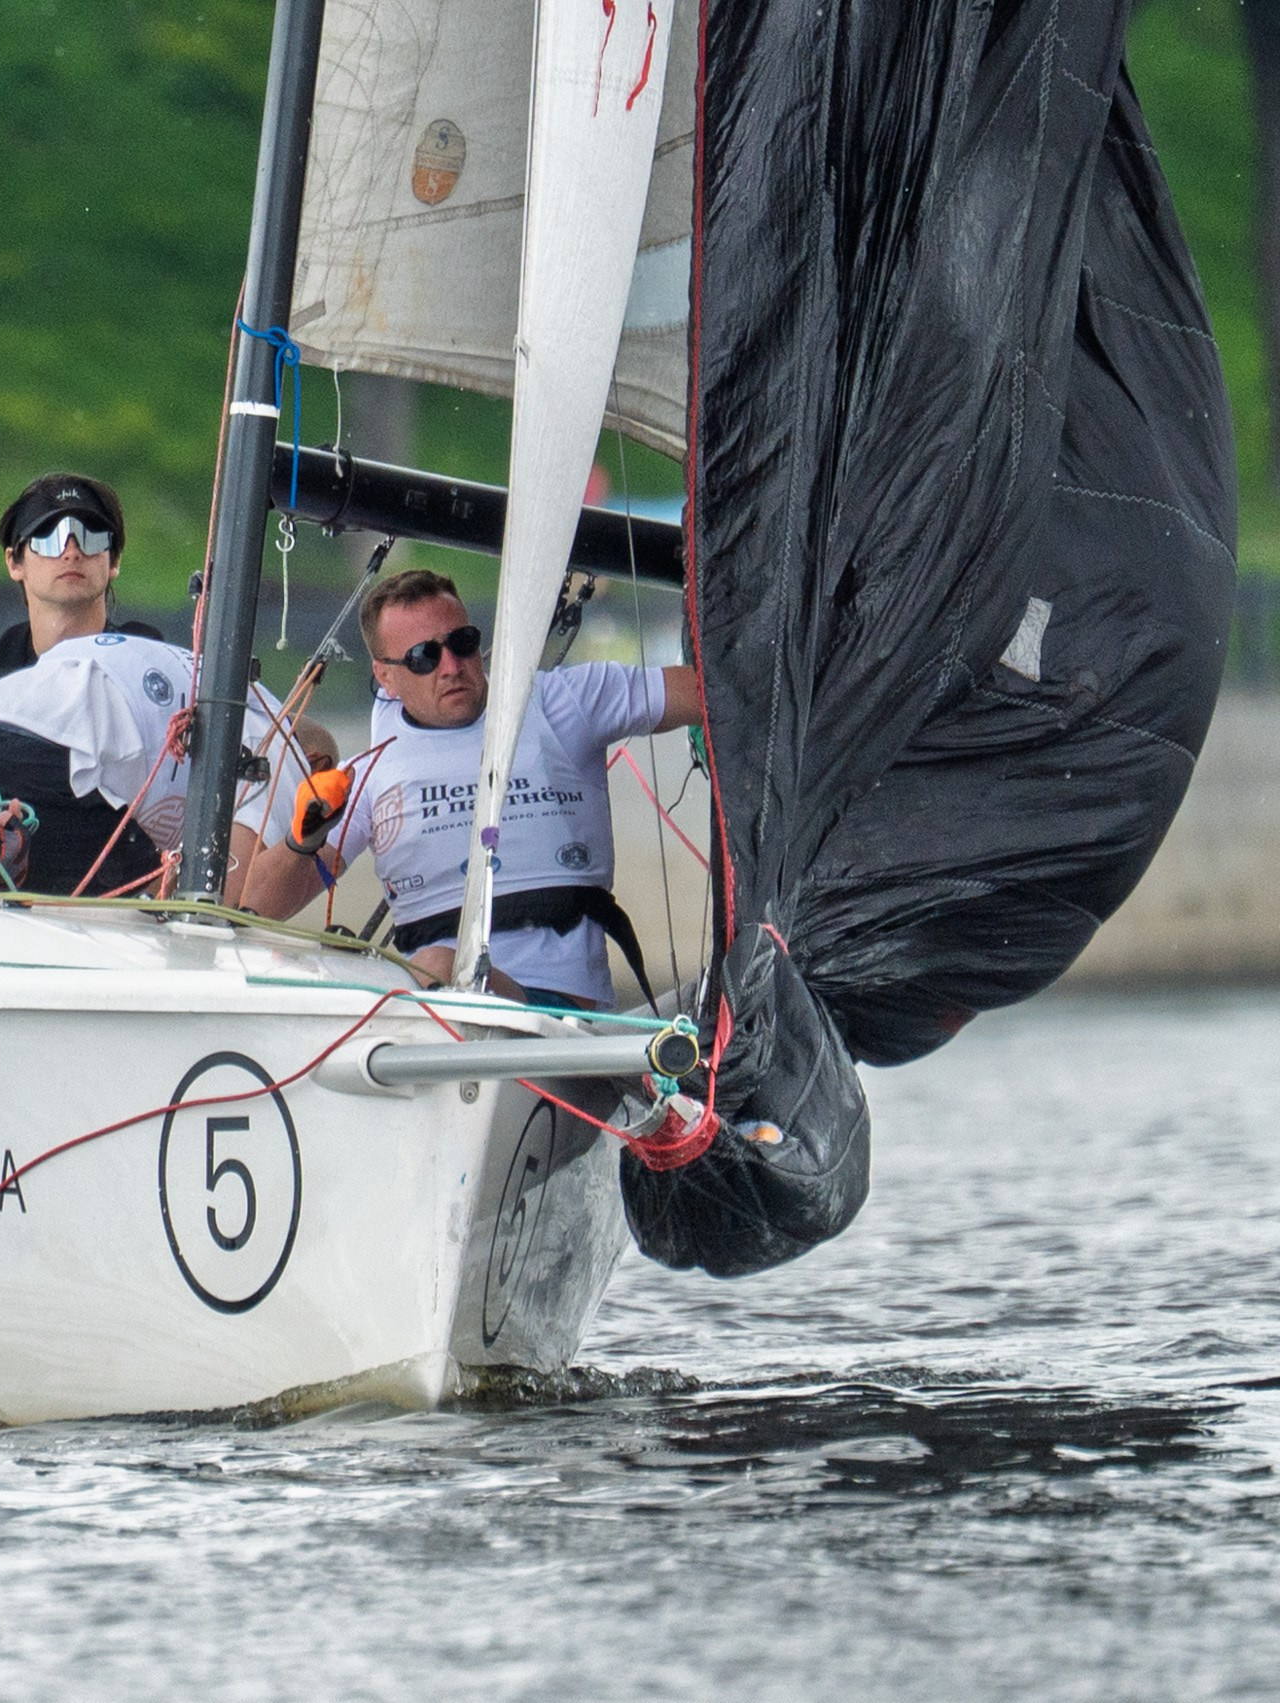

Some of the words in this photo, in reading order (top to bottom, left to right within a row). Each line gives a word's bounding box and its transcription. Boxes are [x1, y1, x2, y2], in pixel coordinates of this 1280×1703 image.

[420, 777, 530, 803] Щегов
[421, 804, 439, 820] и
[448, 786, 584, 814] патнёры
[207, 1116, 256, 1251] 5
[498, 1154, 539, 1287] 5
